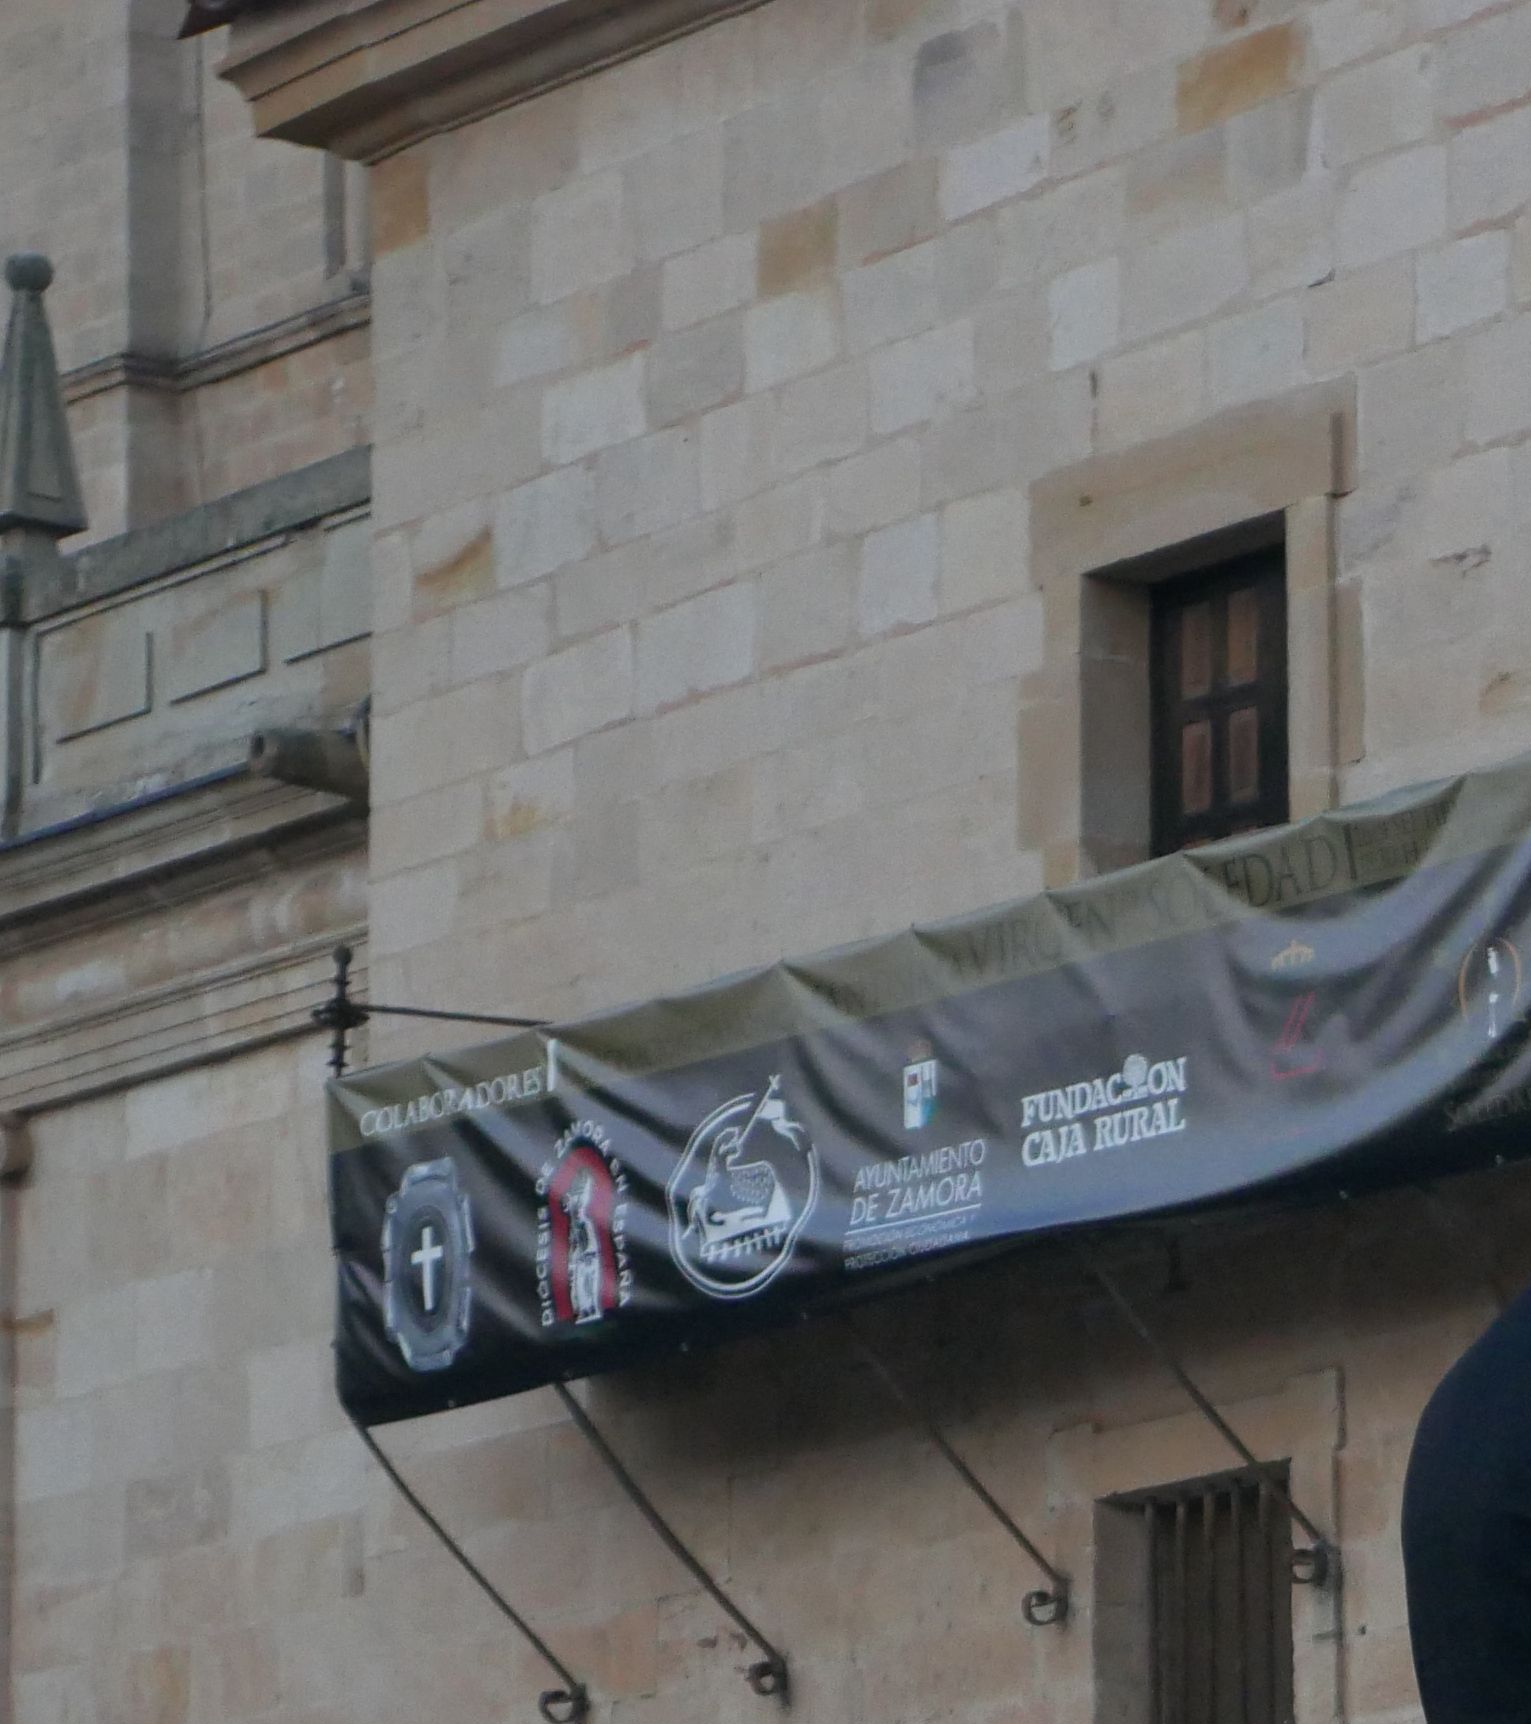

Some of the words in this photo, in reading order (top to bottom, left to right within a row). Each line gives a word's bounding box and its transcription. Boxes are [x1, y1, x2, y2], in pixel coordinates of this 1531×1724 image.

[360, 1065, 543, 1136] COLABORADORES
[1021, 1122, 1087, 1168] CAJA
[1093, 1098, 1187, 1152] RURAL
[853, 1138, 986, 1194] AYUNTAMIENTO
[849, 1195, 879, 1226] DE
[885, 1170, 983, 1218] ZAMORA
